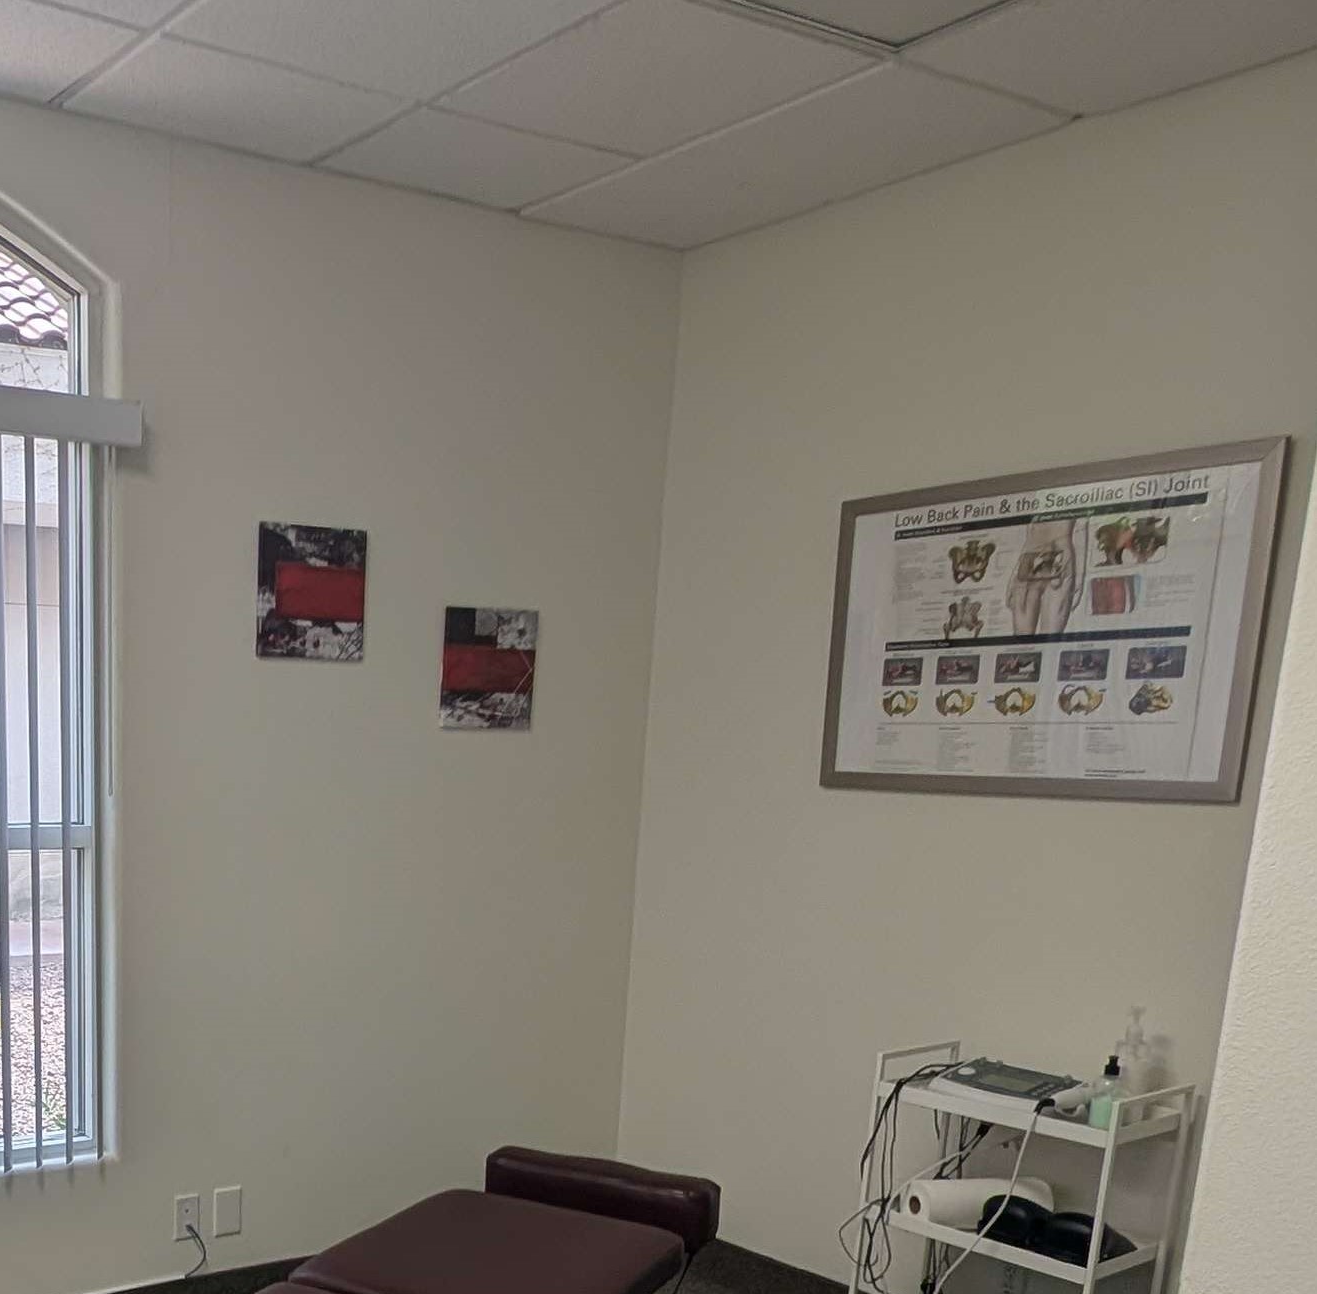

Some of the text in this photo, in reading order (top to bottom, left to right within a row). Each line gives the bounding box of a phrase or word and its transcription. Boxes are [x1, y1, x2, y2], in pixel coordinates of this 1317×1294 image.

[894, 475, 1209, 528] Low Back Pain & the Sacroiliac (SI) Joint
